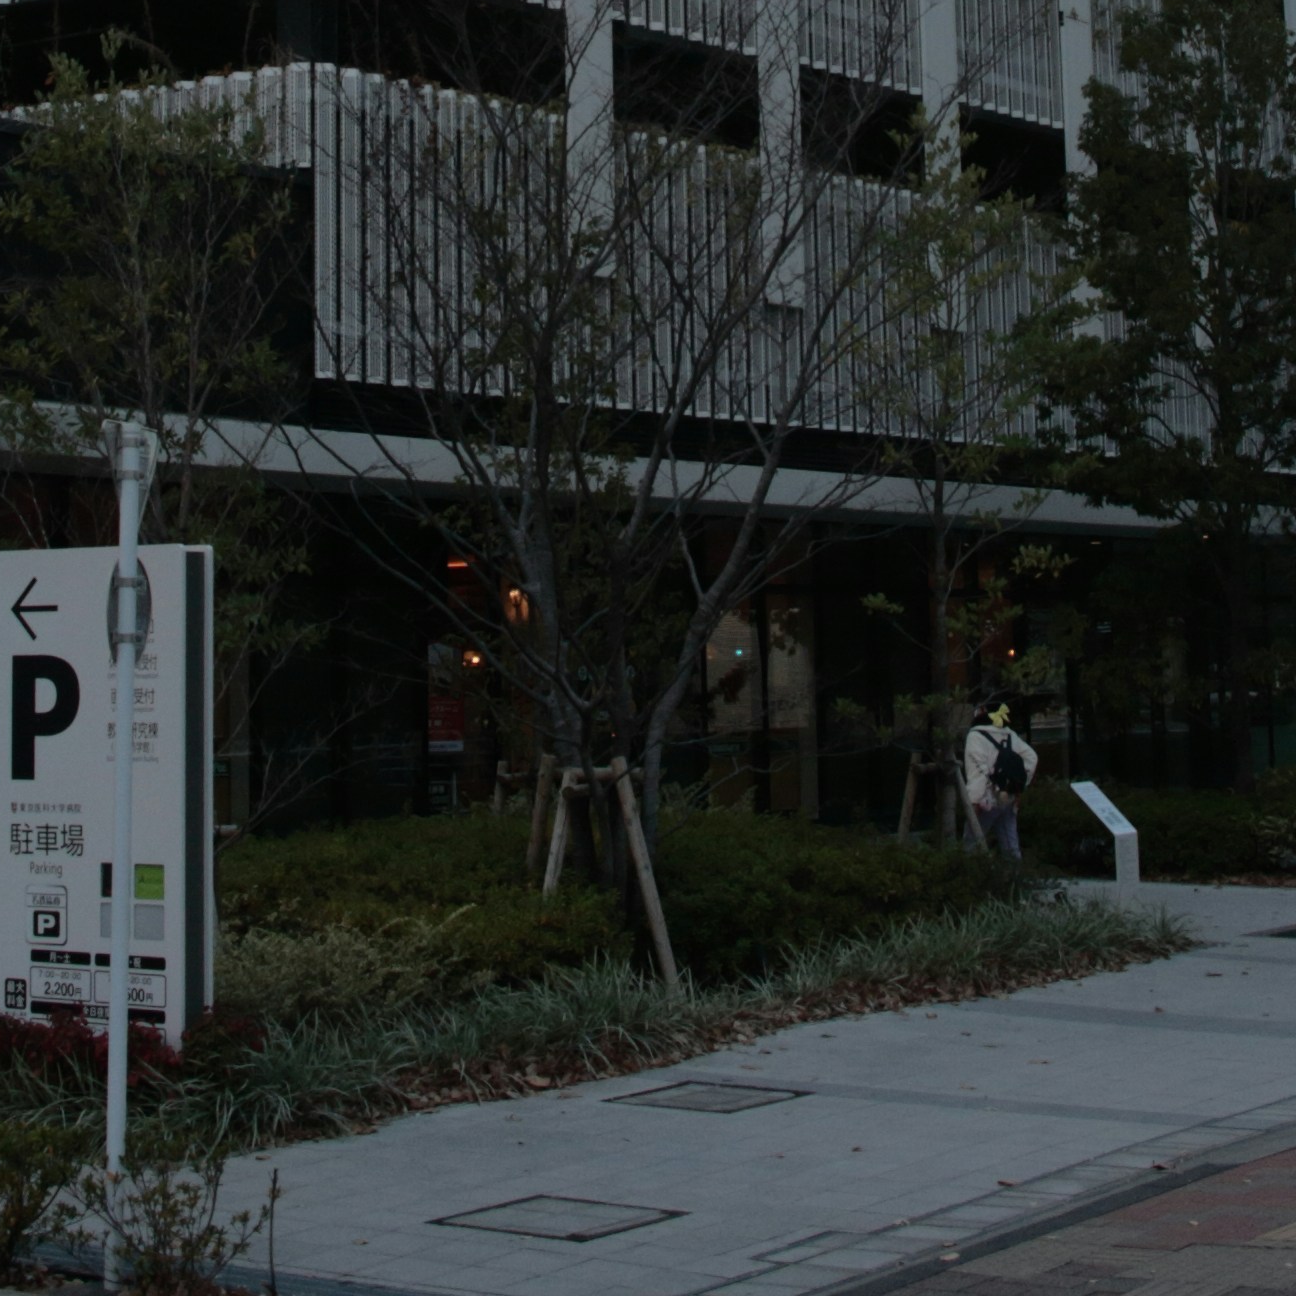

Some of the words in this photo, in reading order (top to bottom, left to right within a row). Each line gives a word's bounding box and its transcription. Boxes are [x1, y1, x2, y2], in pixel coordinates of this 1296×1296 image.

[11, 654, 80, 780] P
[10, 822, 84, 857] 駐車場
[29, 861, 63, 878] Parking
[37, 913, 56, 935] P
